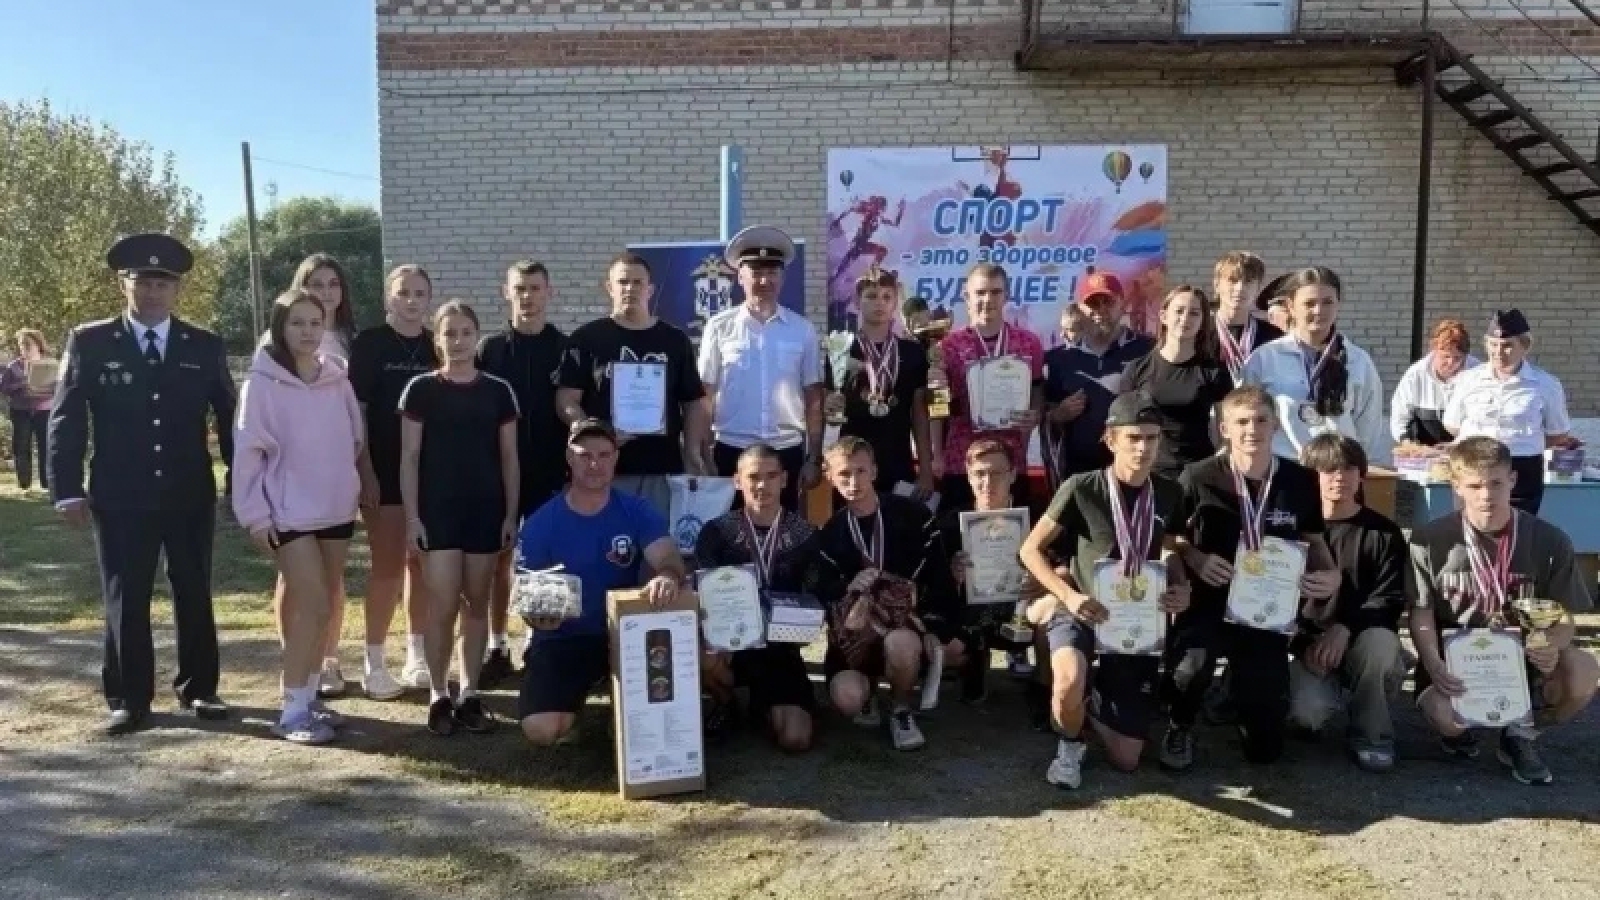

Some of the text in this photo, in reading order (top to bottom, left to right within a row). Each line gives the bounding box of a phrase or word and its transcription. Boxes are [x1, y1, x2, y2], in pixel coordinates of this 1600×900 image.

[933, 199, 1065, 235] СПОРТ
[919, 247, 969, 265] это
[977, 241, 1097, 270] здоровое
